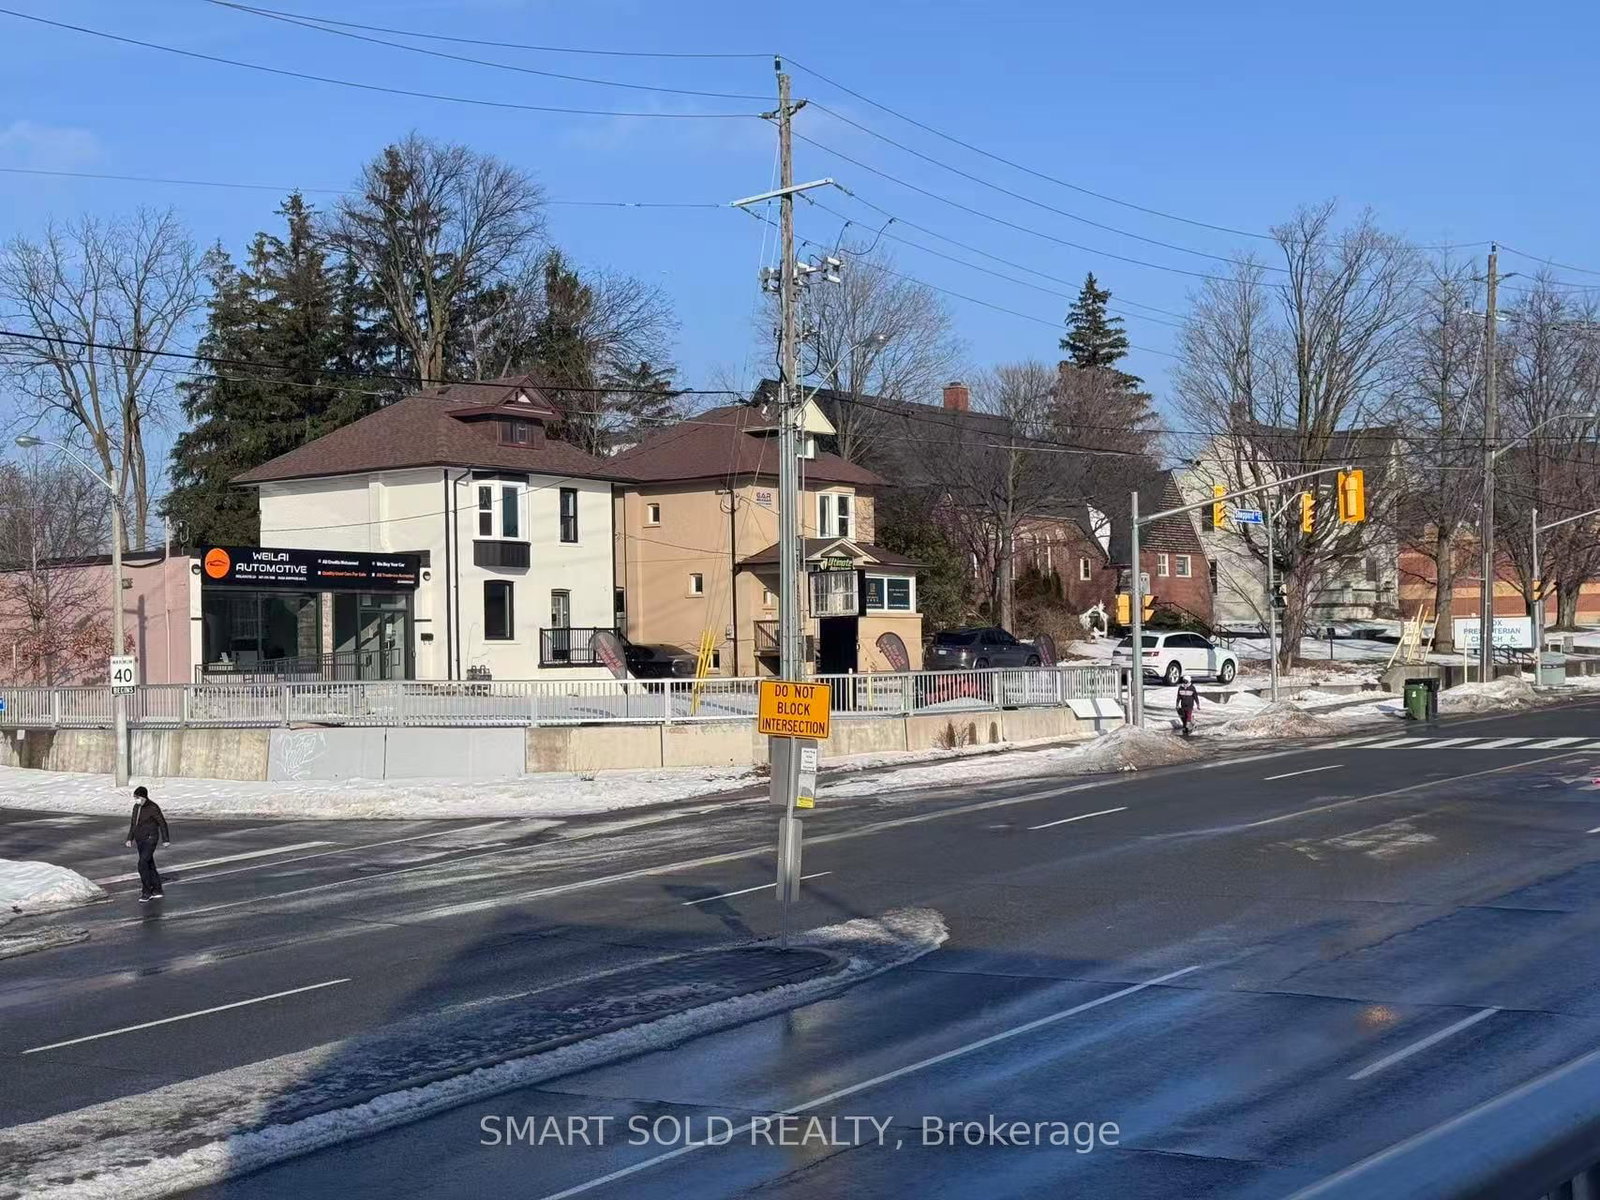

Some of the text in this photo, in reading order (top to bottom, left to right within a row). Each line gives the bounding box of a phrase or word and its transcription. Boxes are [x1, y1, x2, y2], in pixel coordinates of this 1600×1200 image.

[252, 551, 289, 562] WEILAI
[236, 562, 308, 574] AUTOMOTIVE
[114, 668, 132, 683] 40
[774, 684, 815, 699] DO NOT
[777, 702, 810, 716] BLOCK
[762, 718, 825, 734] INTERSECTION
